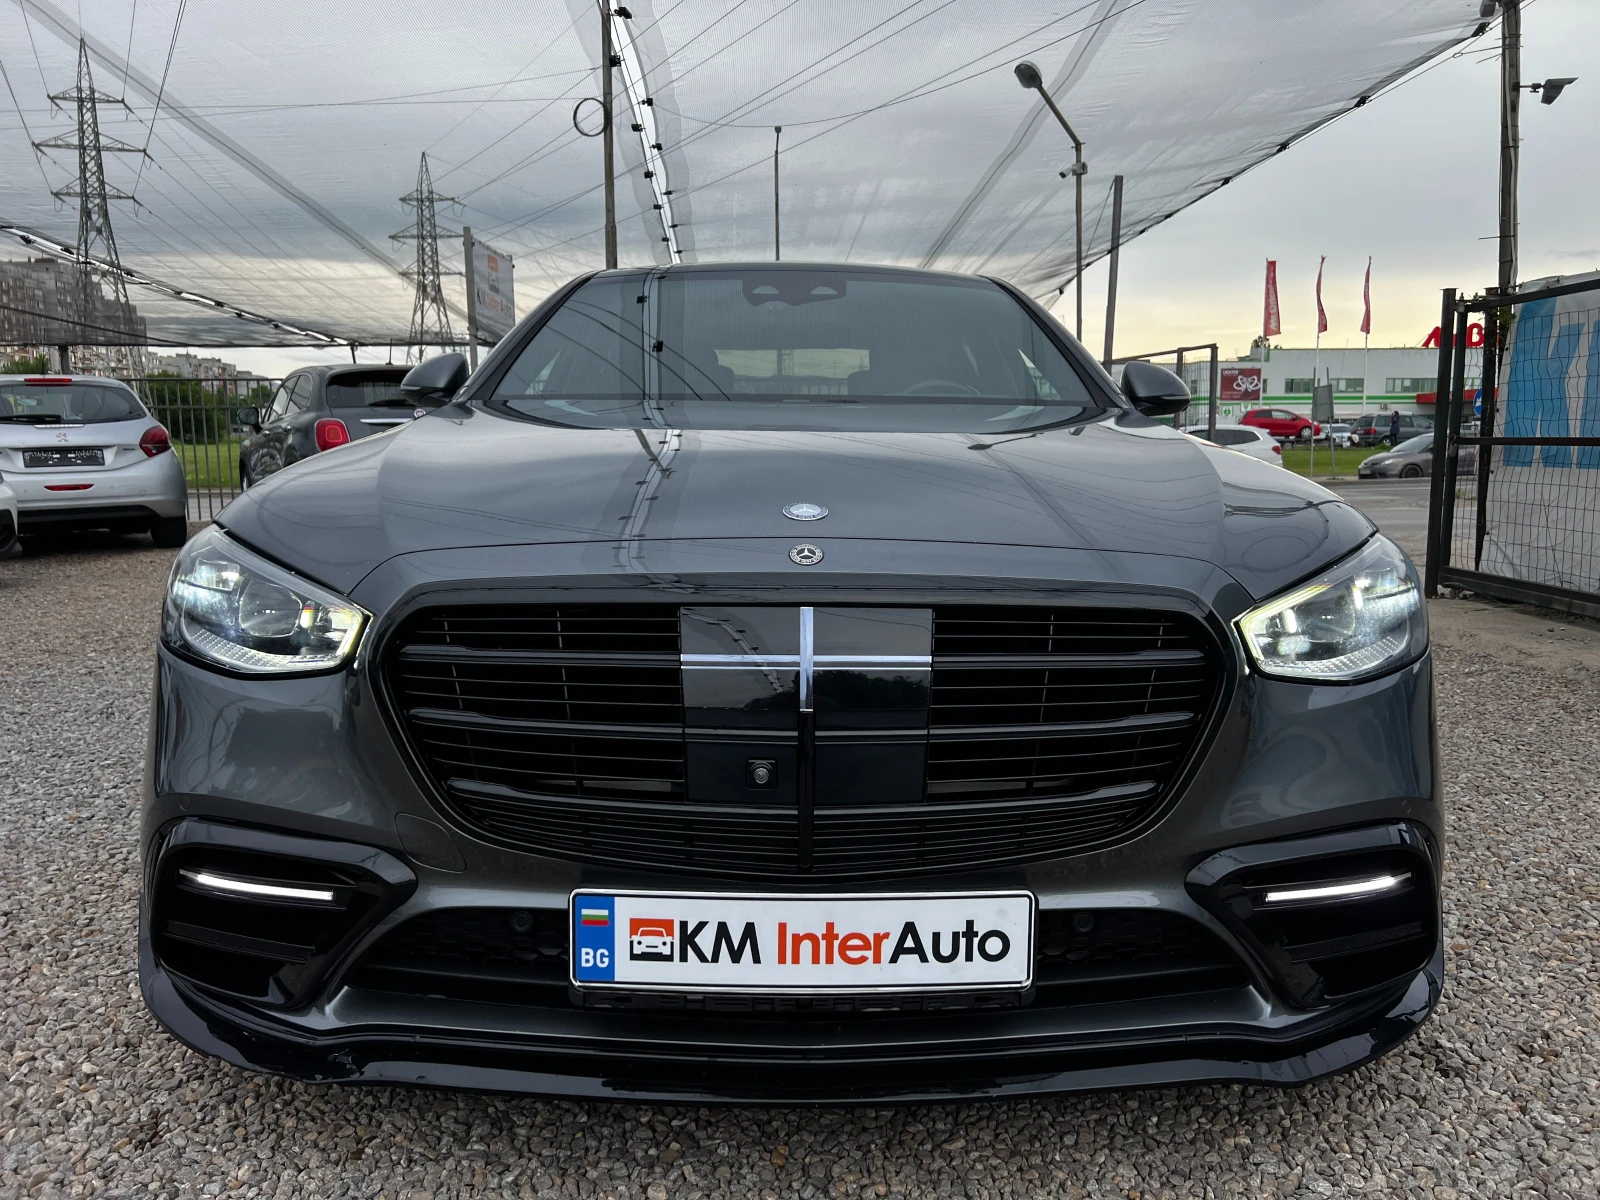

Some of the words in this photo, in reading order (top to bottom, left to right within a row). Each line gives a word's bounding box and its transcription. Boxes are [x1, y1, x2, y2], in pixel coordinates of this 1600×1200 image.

[581, 947, 609, 968] BG
[679, 921, 761, 964] KM
[777, 919, 1011, 965] InterAuto
